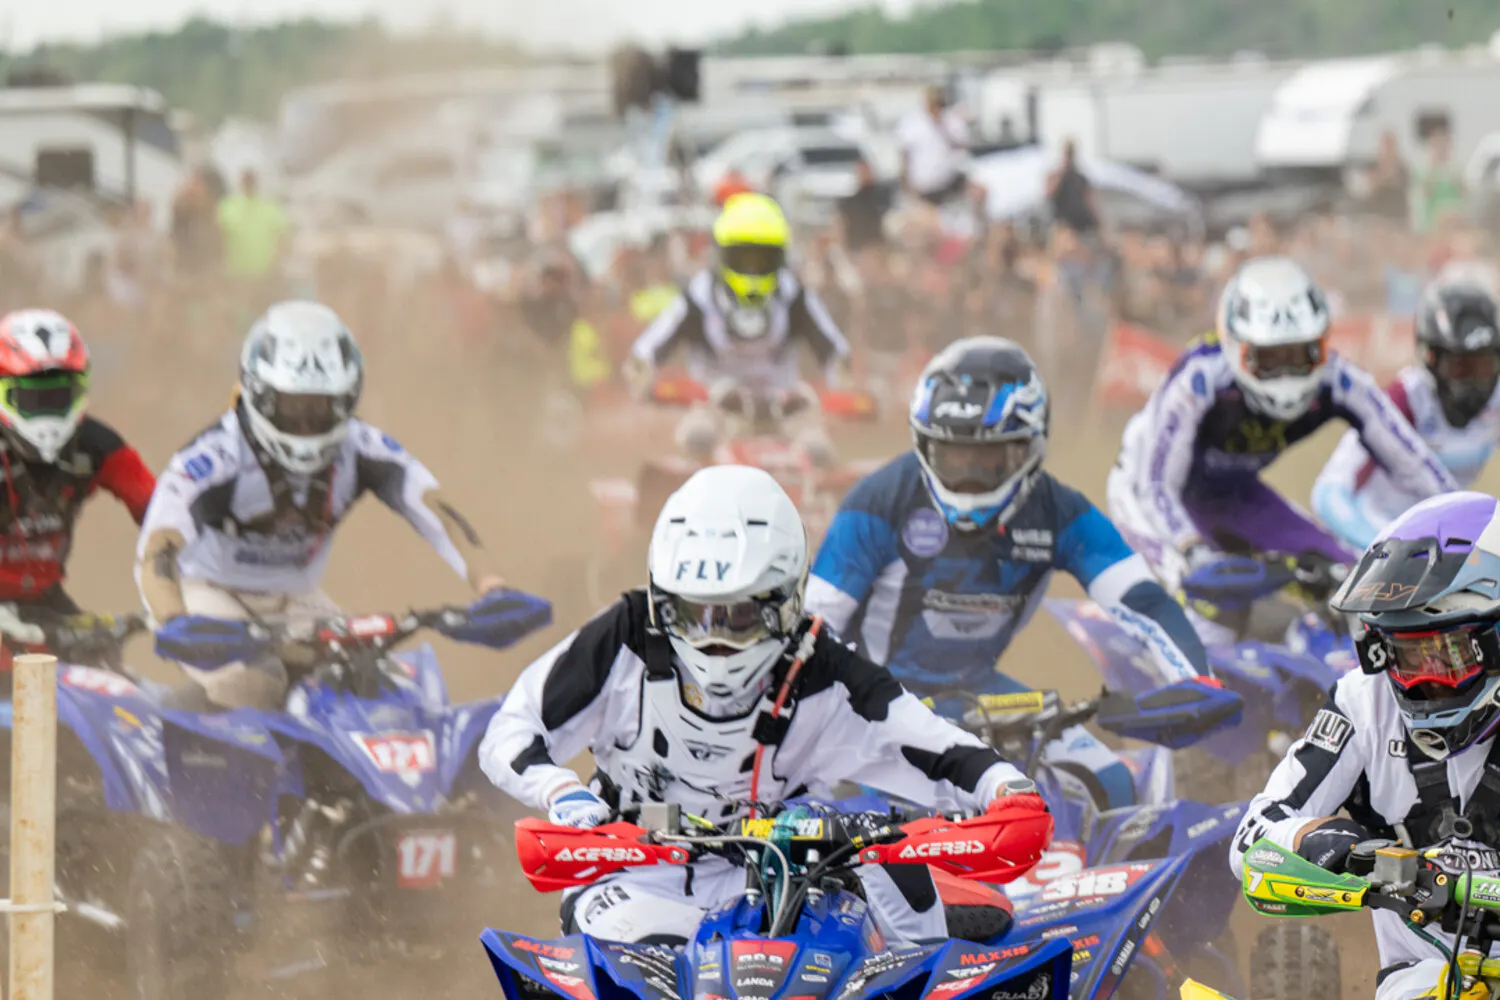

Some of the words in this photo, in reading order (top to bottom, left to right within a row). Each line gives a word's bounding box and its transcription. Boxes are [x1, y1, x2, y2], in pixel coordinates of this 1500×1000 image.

[676, 559, 732, 581] FLY
[401, 836, 455, 878] 171
[554, 847, 646, 862] ACERBIS
[900, 840, 985, 858] ACERBIS
[960, 946, 1029, 966] MAXXIS
[736, 977, 774, 987] LANDA
[991, 991, 1038, 1000] QUAD
